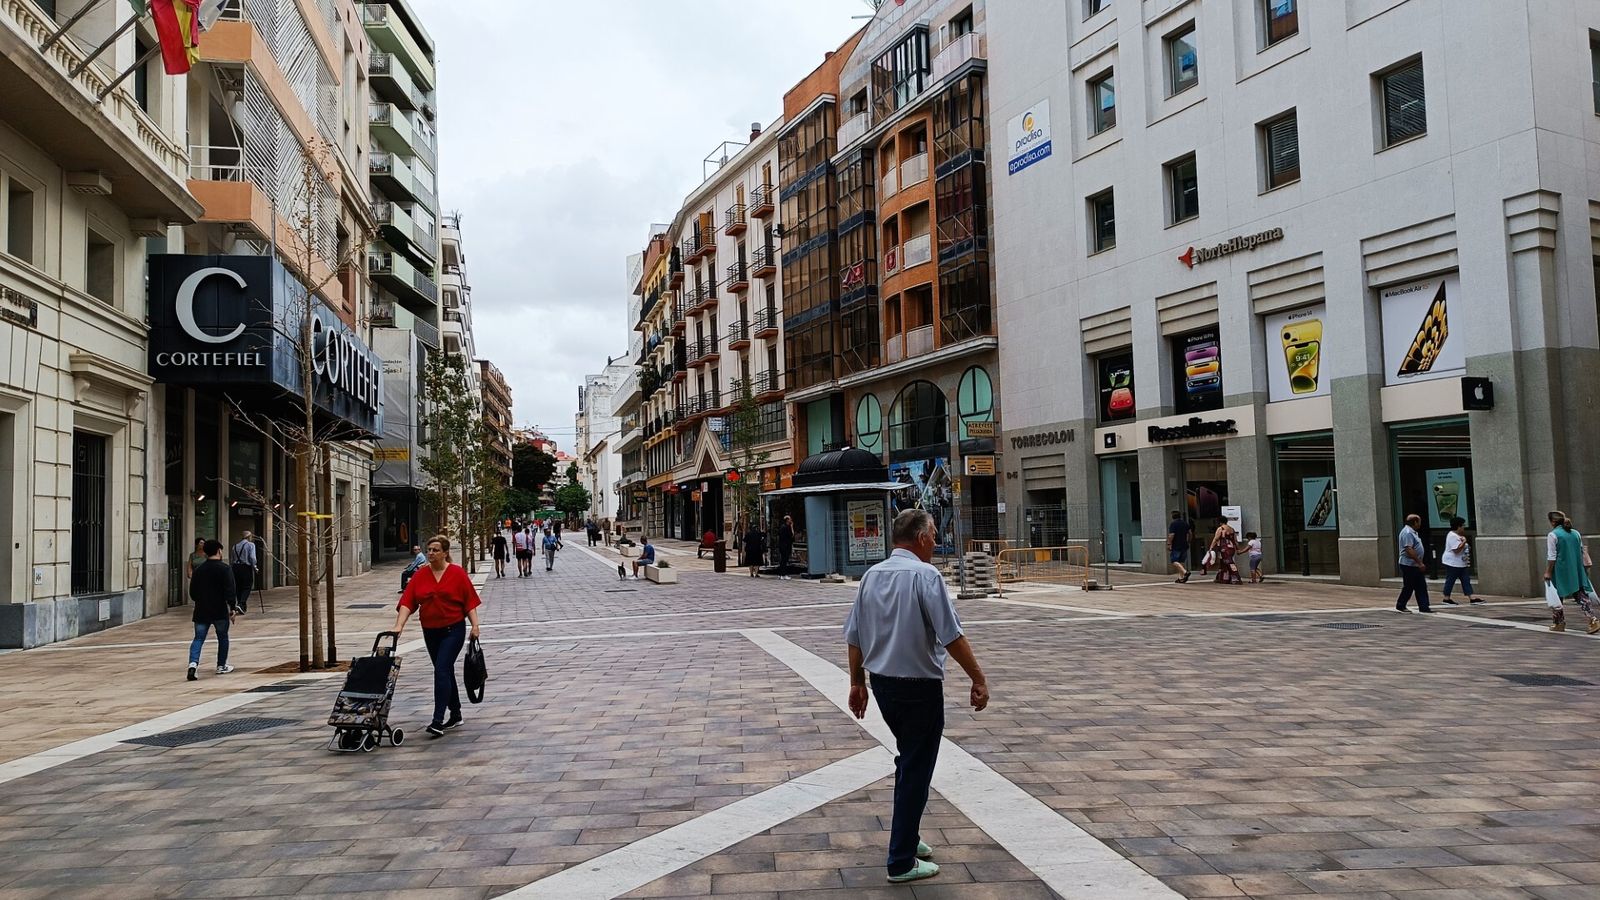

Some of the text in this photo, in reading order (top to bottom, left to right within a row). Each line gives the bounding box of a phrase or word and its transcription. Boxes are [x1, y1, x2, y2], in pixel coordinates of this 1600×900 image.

[1196, 227, 1284, 263] NorteHispana
[1388, 286, 1414, 297] MacBook
[175, 267, 248, 344] C
[156, 351, 266, 366] CORTEFIEL
[311, 313, 381, 416] CORTEFIEL
[1295, 354, 1310, 362] 9:41
[1010, 429, 1075, 450] TORRECOLON
